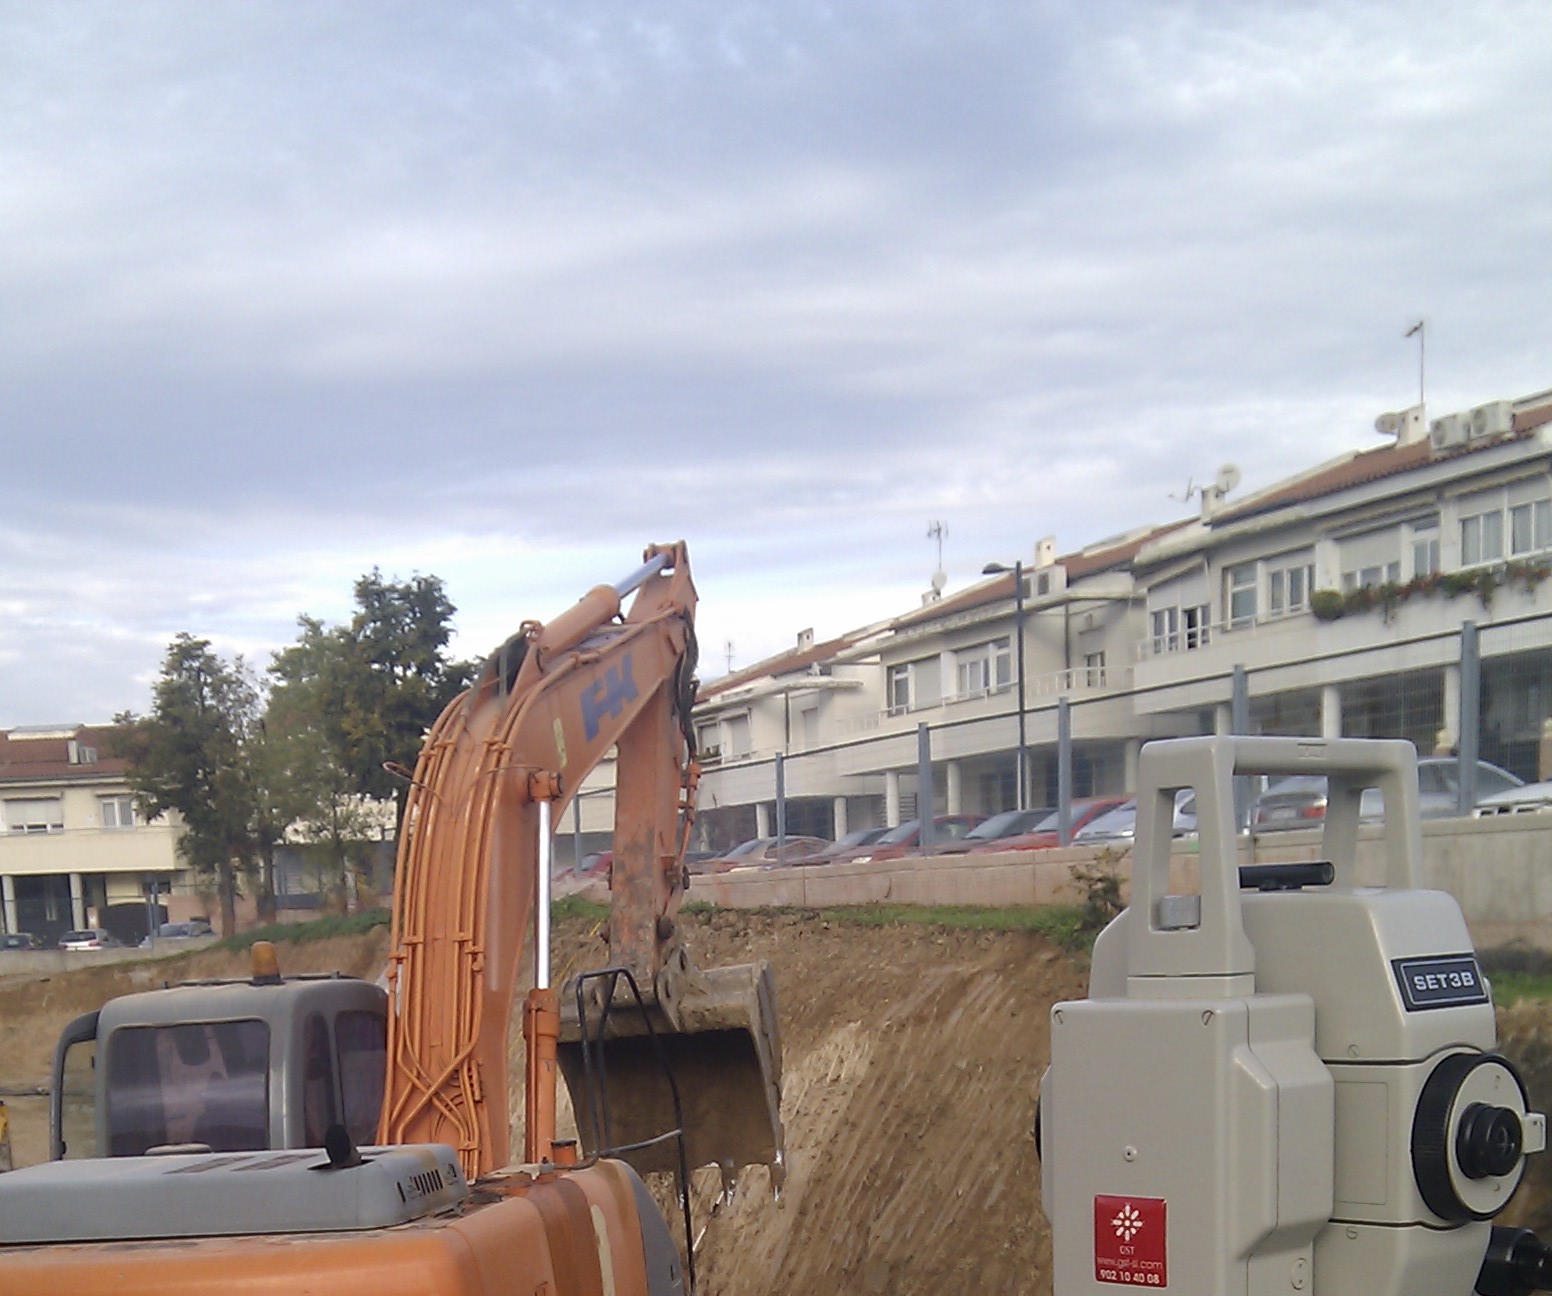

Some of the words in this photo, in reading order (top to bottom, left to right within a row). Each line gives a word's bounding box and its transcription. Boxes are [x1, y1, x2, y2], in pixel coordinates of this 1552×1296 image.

[1413, 971, 1475, 991] SET3B
[1100, 1269, 1117, 1281] 902
[1120, 1271, 1131, 1282] 10
[1133, 1273, 1145, 1283] 40
[1146, 1273, 1160, 1284] 08
